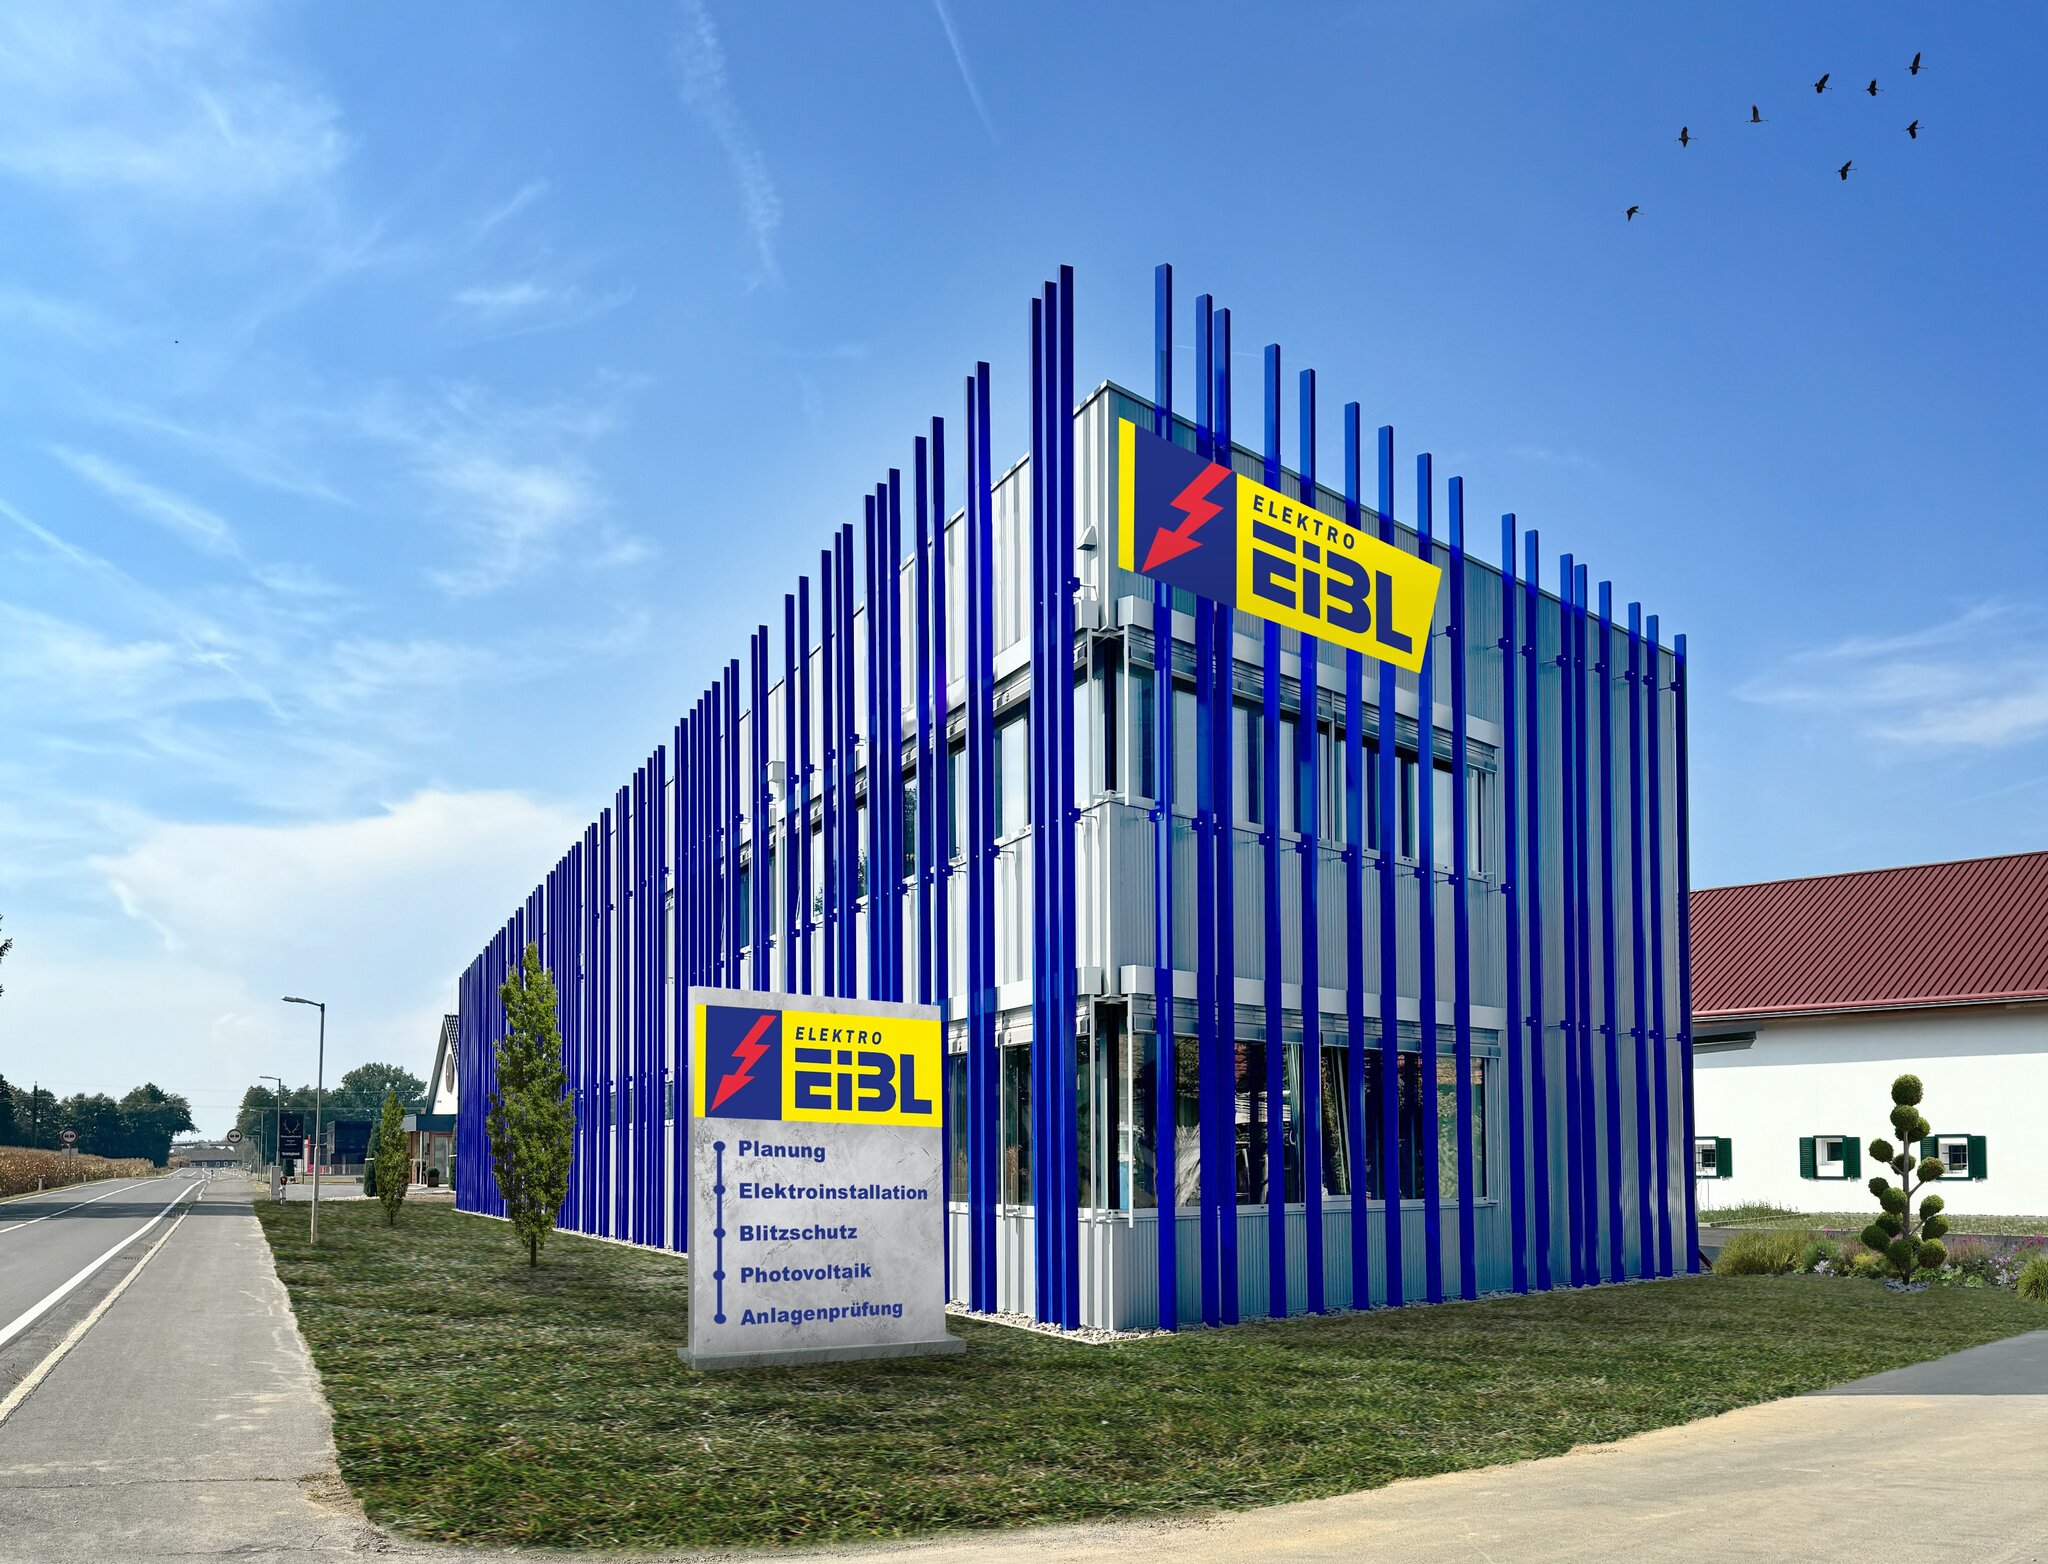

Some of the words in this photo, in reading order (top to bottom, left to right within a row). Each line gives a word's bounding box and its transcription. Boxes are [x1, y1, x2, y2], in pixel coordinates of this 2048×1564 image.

[1253, 494, 1355, 550] ELEKTRO
[795, 1026, 882, 1045] ELEKTRO
[738, 1140, 826, 1162] Planung
[739, 1182, 928, 1200] Elektroinstallation
[740, 1224, 858, 1241] Blitzschutz
[741, 1263, 872, 1283] Photovoltaik
[740, 1301, 903, 1326] Anlagenprüfung
